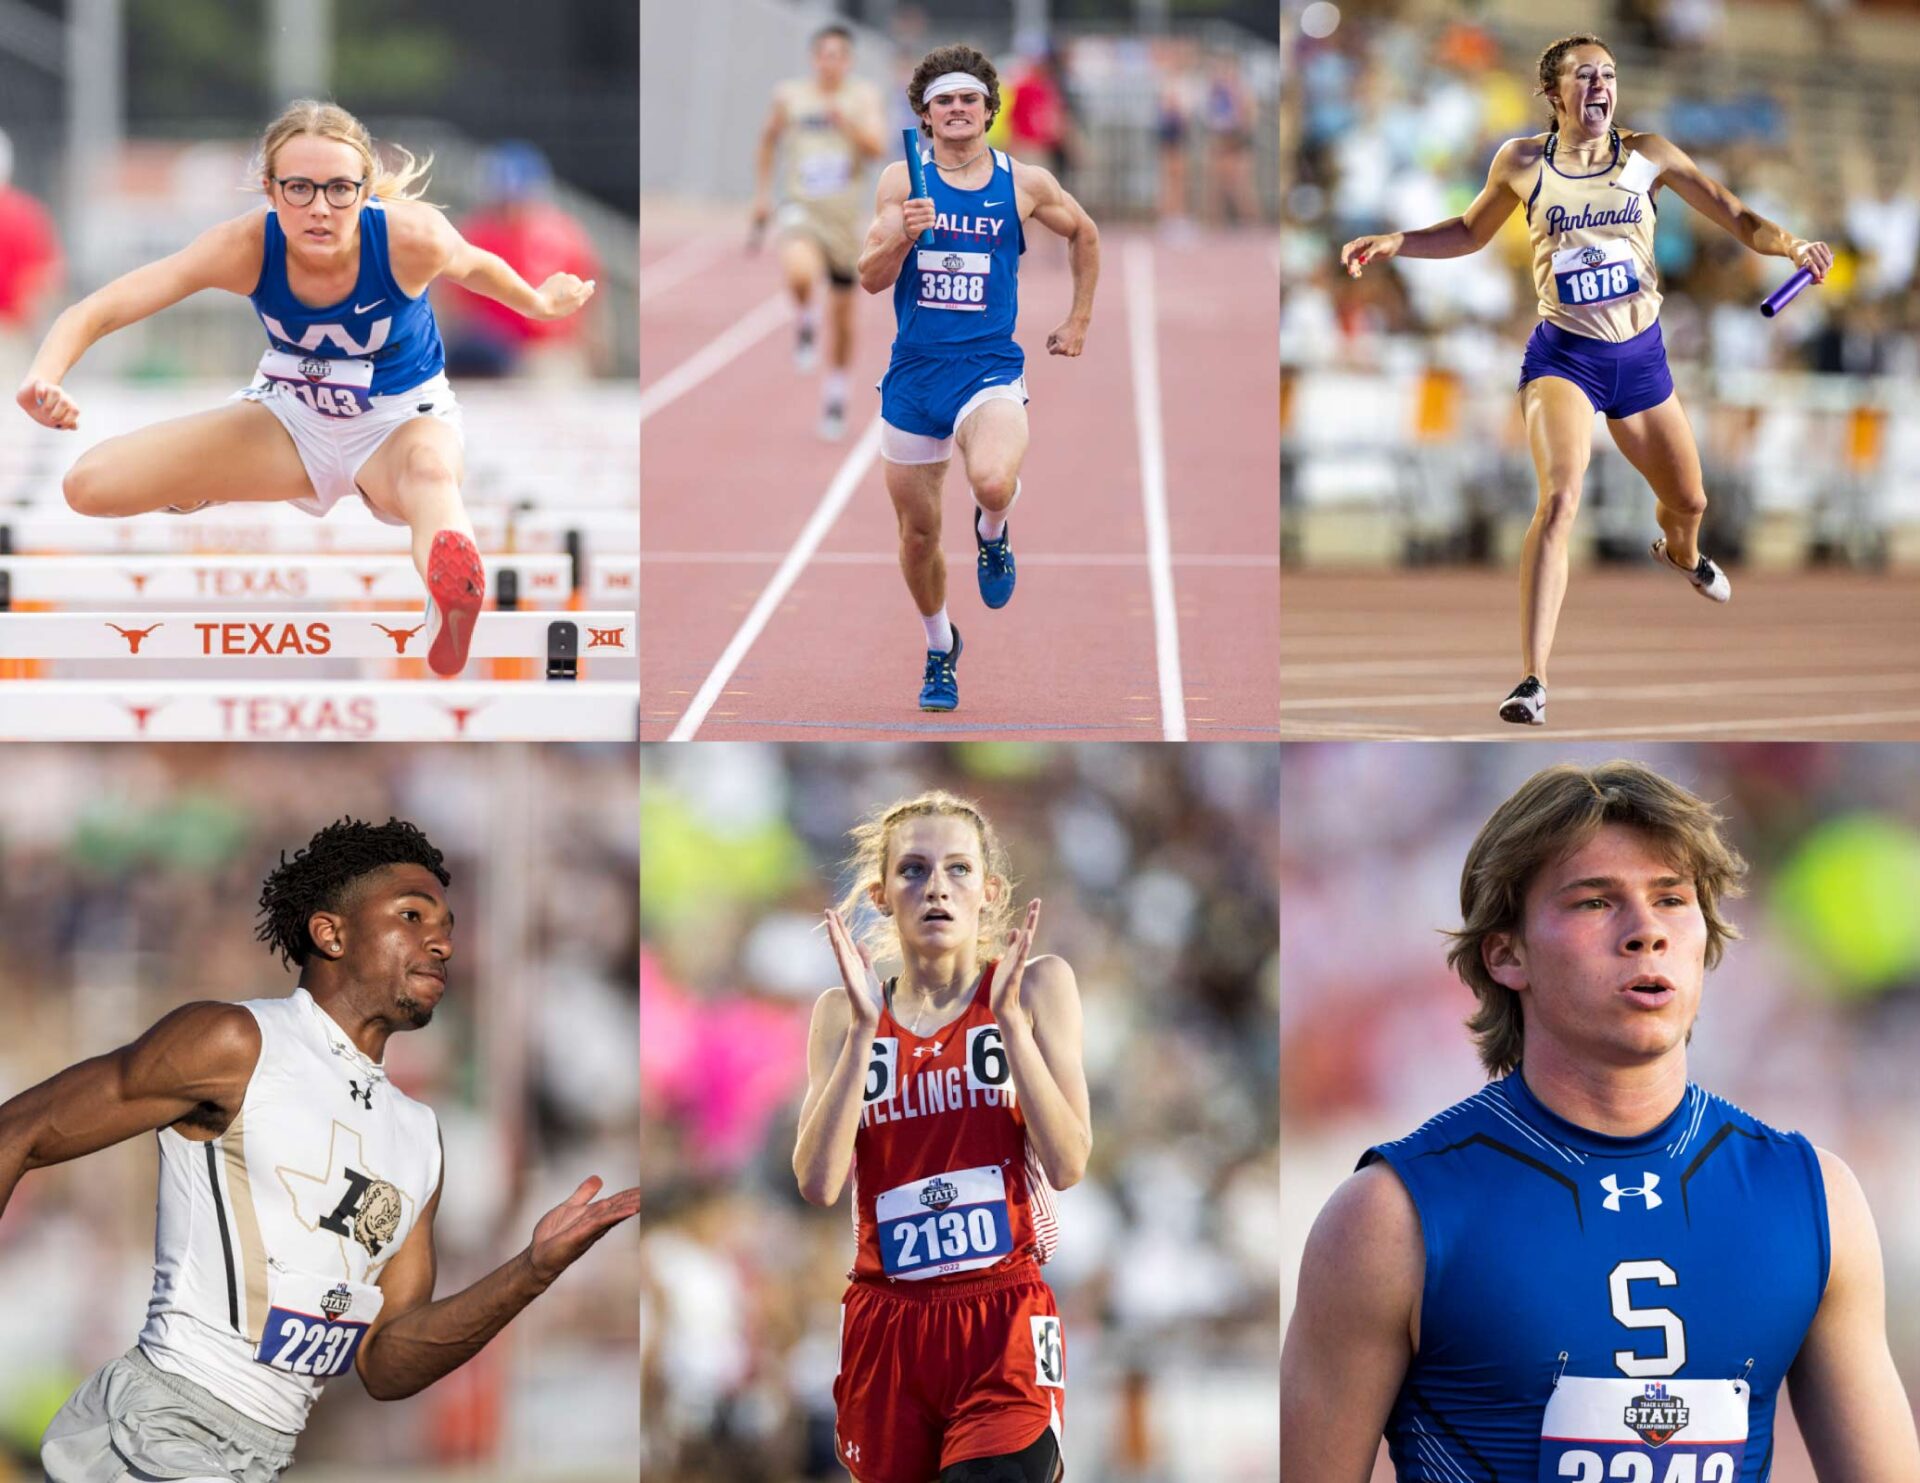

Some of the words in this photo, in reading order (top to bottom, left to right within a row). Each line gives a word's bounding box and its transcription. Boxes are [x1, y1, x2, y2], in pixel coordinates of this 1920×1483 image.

[934, 212, 1004, 236] ALLEY
[1546, 196, 1642, 236] Panhandle
[922, 273, 984, 302] 3388
[1566, 265, 1628, 303] 1878
[194, 567, 308, 596] TEXAS
[194, 622, 331, 655] TEXAS
[587, 627, 625, 648] XII
[217, 698, 378, 738] TEXAS
[972, 1028, 1010, 1085] 6
[920, 1188, 958, 1203] STATE
[893, 1208, 997, 1267] 2130
[939, 1263, 960, 1273] 2022
[321, 1296, 351, 1310] STATE
[1609, 1259, 1687, 1378] S
[271, 1318, 359, 1376] 2237
[1625, 1407, 1688, 1424] STATE
